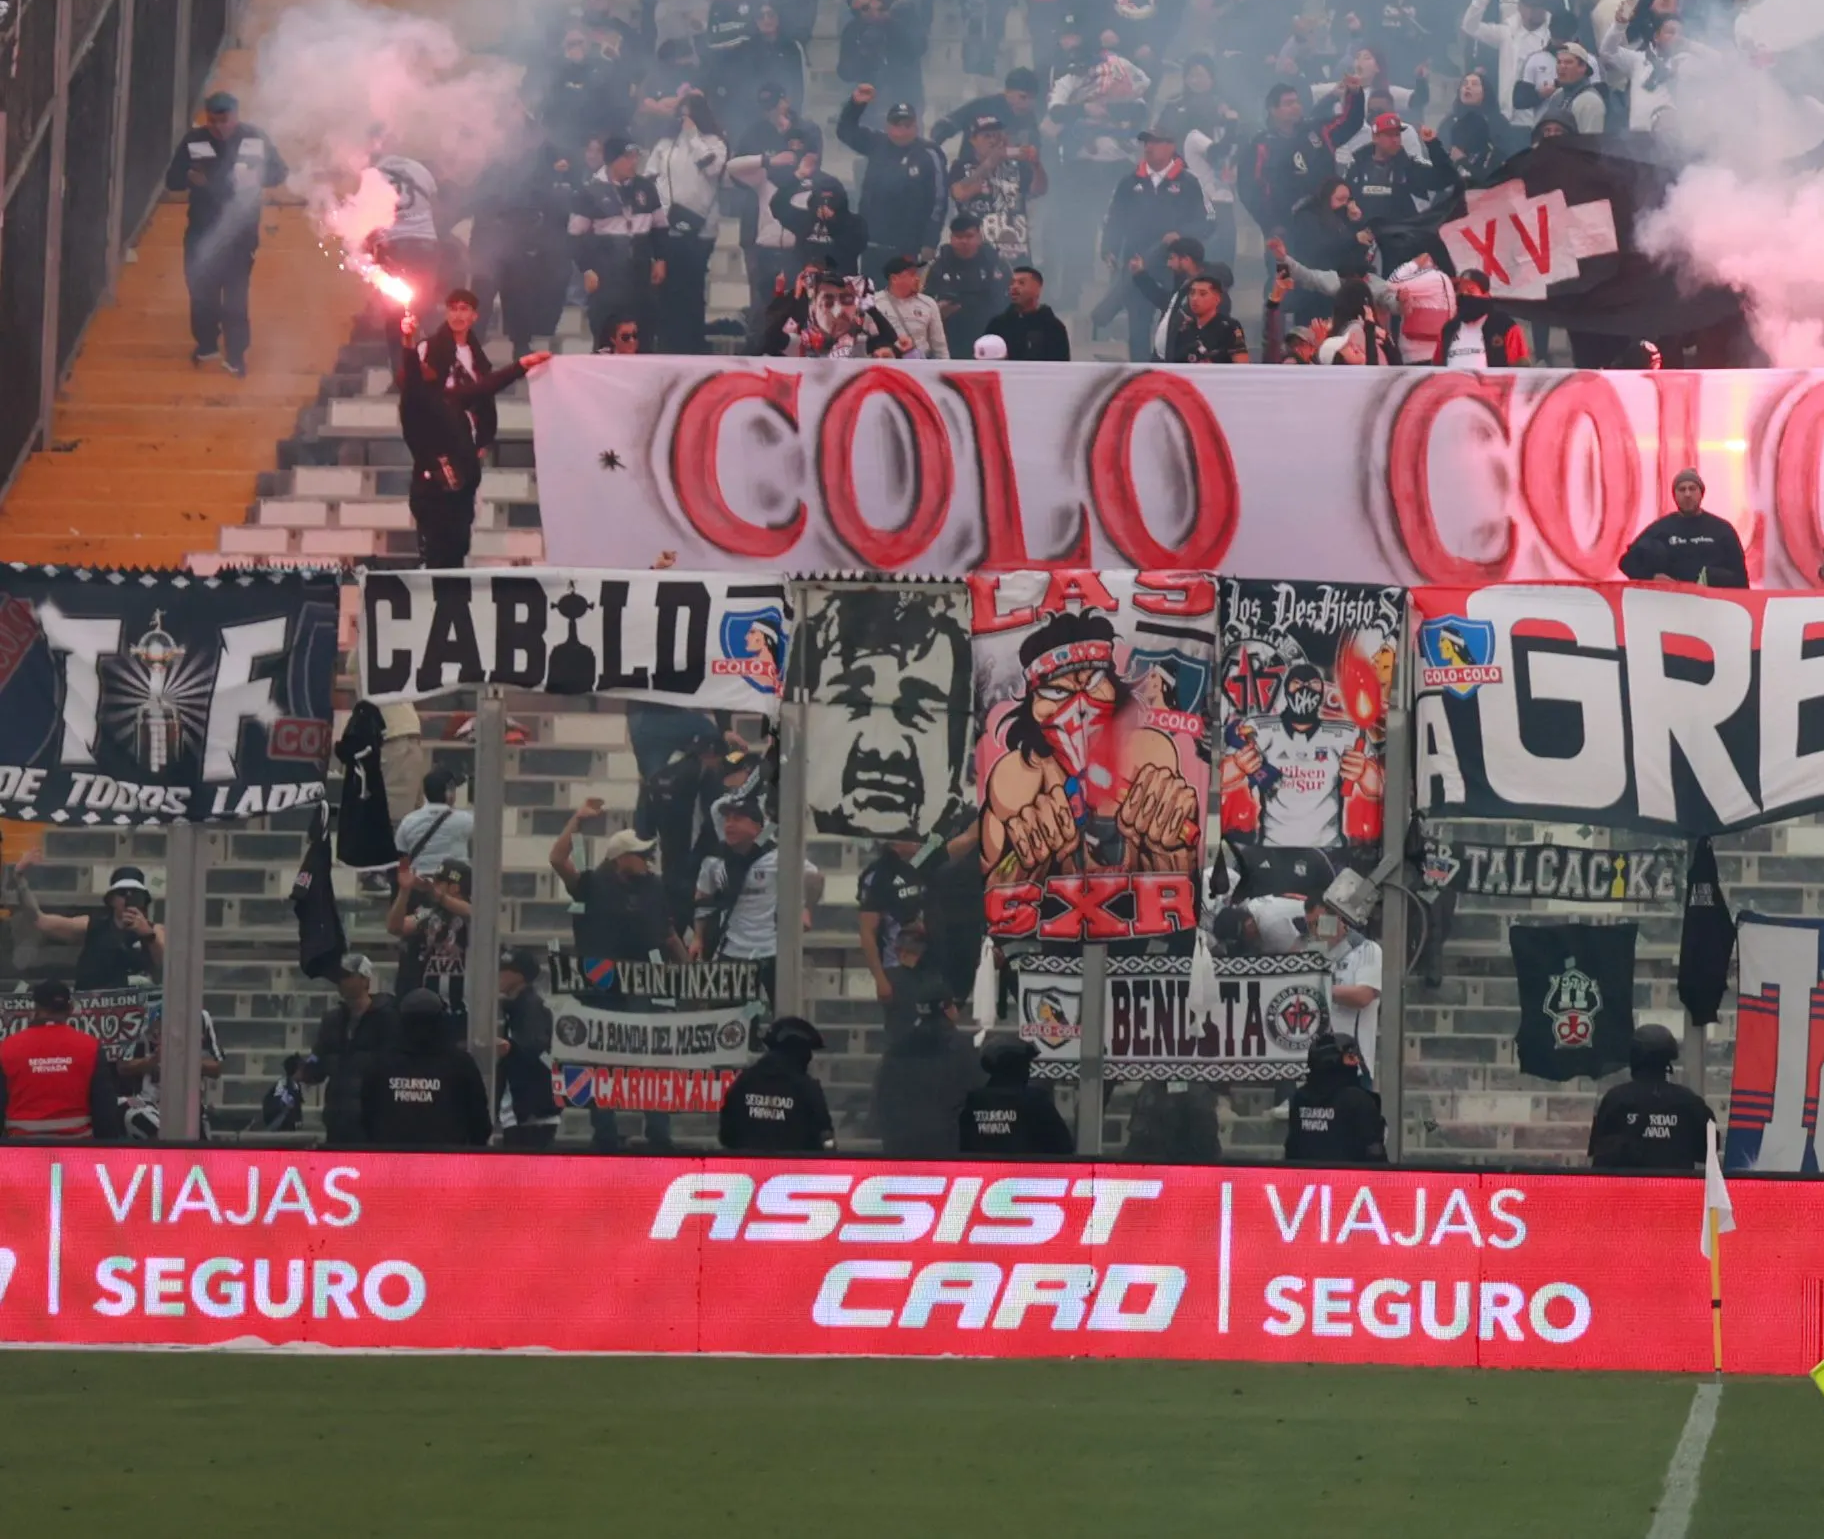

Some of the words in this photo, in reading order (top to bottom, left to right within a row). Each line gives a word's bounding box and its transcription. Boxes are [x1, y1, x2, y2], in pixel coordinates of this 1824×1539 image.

[1460, 205, 1550, 286] XV
[668, 363, 1244, 573] COLO
[966, 569, 1217, 636] LAS
[65, 772, 192, 815] TODOS
[985, 871, 1198, 943] SXR
[388, 1077, 441, 1091] SEGURIDAD
[394, 1090, 434, 1103] PRIVADA
[94, 1163, 362, 1228] VIAJAS
[648, 1172, 1163, 1247] ASSIST
[1264, 1184, 1528, 1250] VIAJAS
[93, 1256, 428, 1323] SEGURO
[811, 1260, 1187, 1333] CARD
[1262, 1275, 1592, 1344] SEGURO
